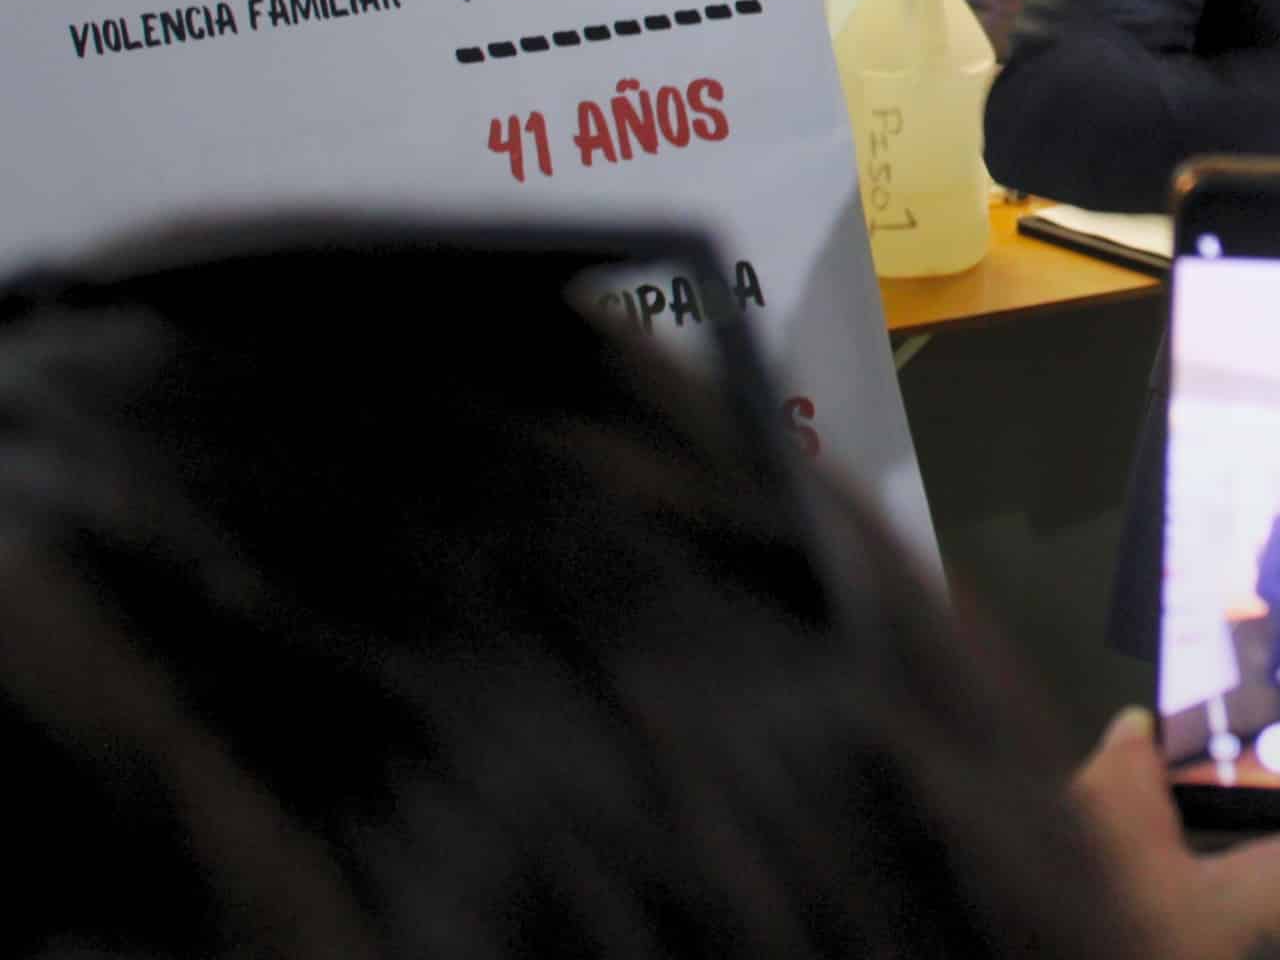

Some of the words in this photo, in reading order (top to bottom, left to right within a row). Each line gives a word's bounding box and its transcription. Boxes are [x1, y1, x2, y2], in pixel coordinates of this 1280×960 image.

[69, 1, 239, 59] VIOLENCIA
[488, 110, 554, 184] 41
[573, 77, 730, 168] AÑOS
